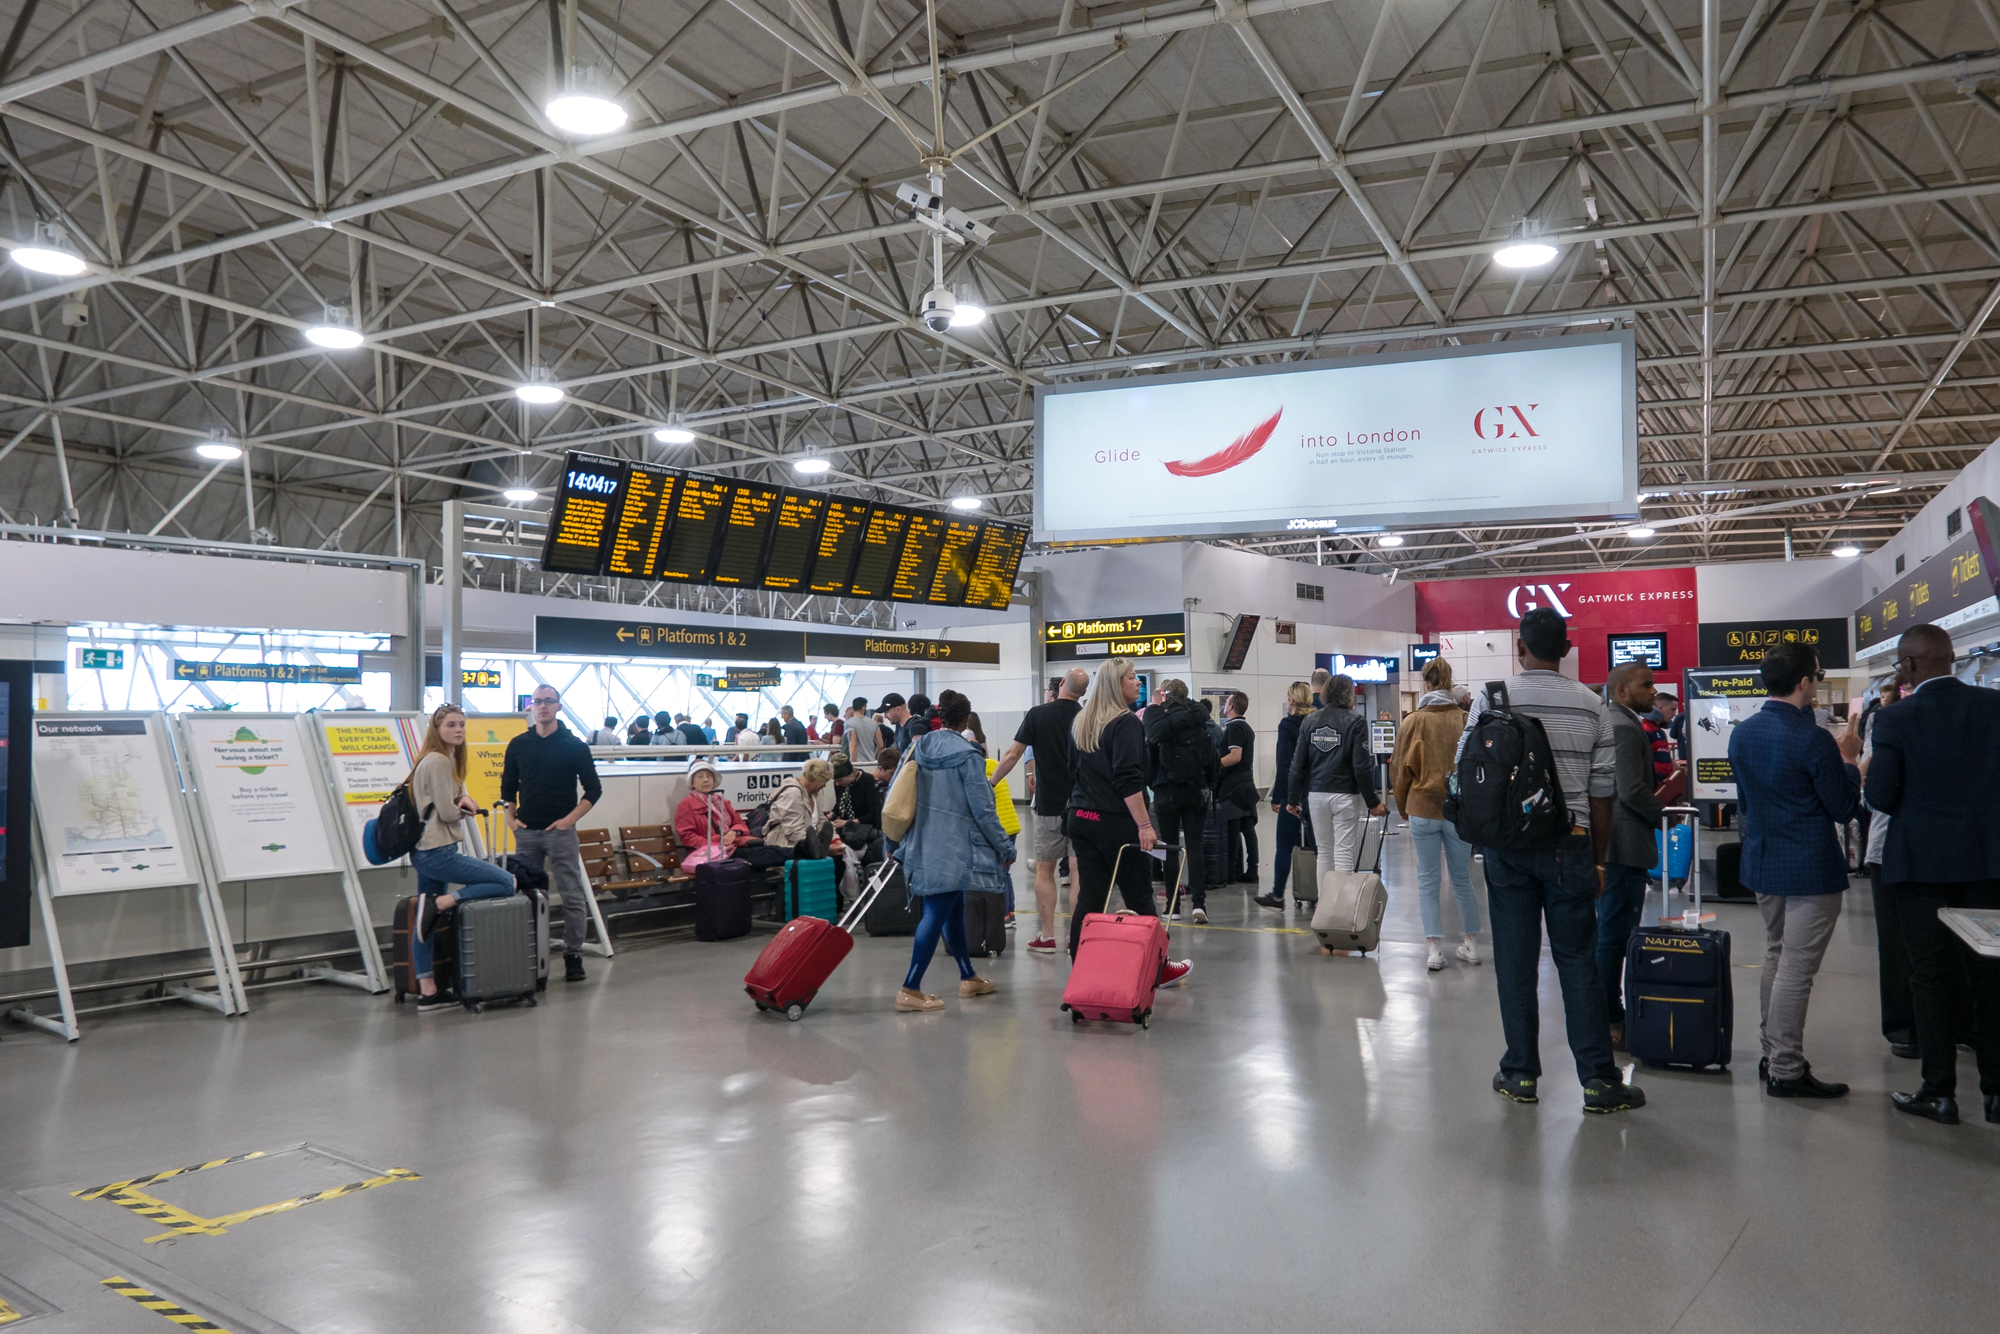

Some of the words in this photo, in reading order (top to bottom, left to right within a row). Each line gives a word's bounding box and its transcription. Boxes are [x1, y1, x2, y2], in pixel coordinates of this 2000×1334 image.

[1474, 403, 1540, 440] GX
[1300, 434, 1338, 448] into
[1348, 428, 1421, 445] London
[1094, 448, 1141, 464] Glide
[1316, 450, 1346, 458] Non-stop
[1472, 446, 1508, 454] GATWICK
[577, 454, 598, 464] Special
[599, 457, 620, 467] Notices
[630, 462, 643, 471] Next
[644, 464, 662, 474] fastest
[662, 467, 674, 476] train
[688, 472, 716, 482] Departures
[682, 488, 700, 497] London
[701, 491, 720, 500] Victoria
[734, 496, 751, 504] London
[751, 498, 769, 507] Victoria
[1286, 518, 1338, 530] JCDecaux
[1507, 583, 1572, 618] GX
[1578, 592, 1634, 604] GATWICK
[1640, 590, 1694, 601] EXPRESS
[1076, 620, 1124, 635] Platforms
[1126, 618, 1144, 631] 1-7
[657, 627, 716, 645] Platforms
[718, 632, 724, 645] 1
[727, 632, 737, 646] &
[739, 633, 747, 646] 2
[865, 639, 909, 654] Platforms
[910, 642, 925, 654] 3-7
[1111, 642, 1151, 655] Lounge
[1740, 648, 1766, 660] Assi
[214, 664, 268, 678] Platforms
[270, 669, 275, 678] 1
[277, 668, 286, 678] &
[286, 668, 294, 679] 2
[462, 672, 477, 683] 3-7
[1712, 678, 1753, 688] Pre-Paid
[38, 725, 60, 733] Our
[476, 750, 504, 758] When
[737, 791, 771, 803] Priority
[1645, 936, 1700, 948] NAUTICA
